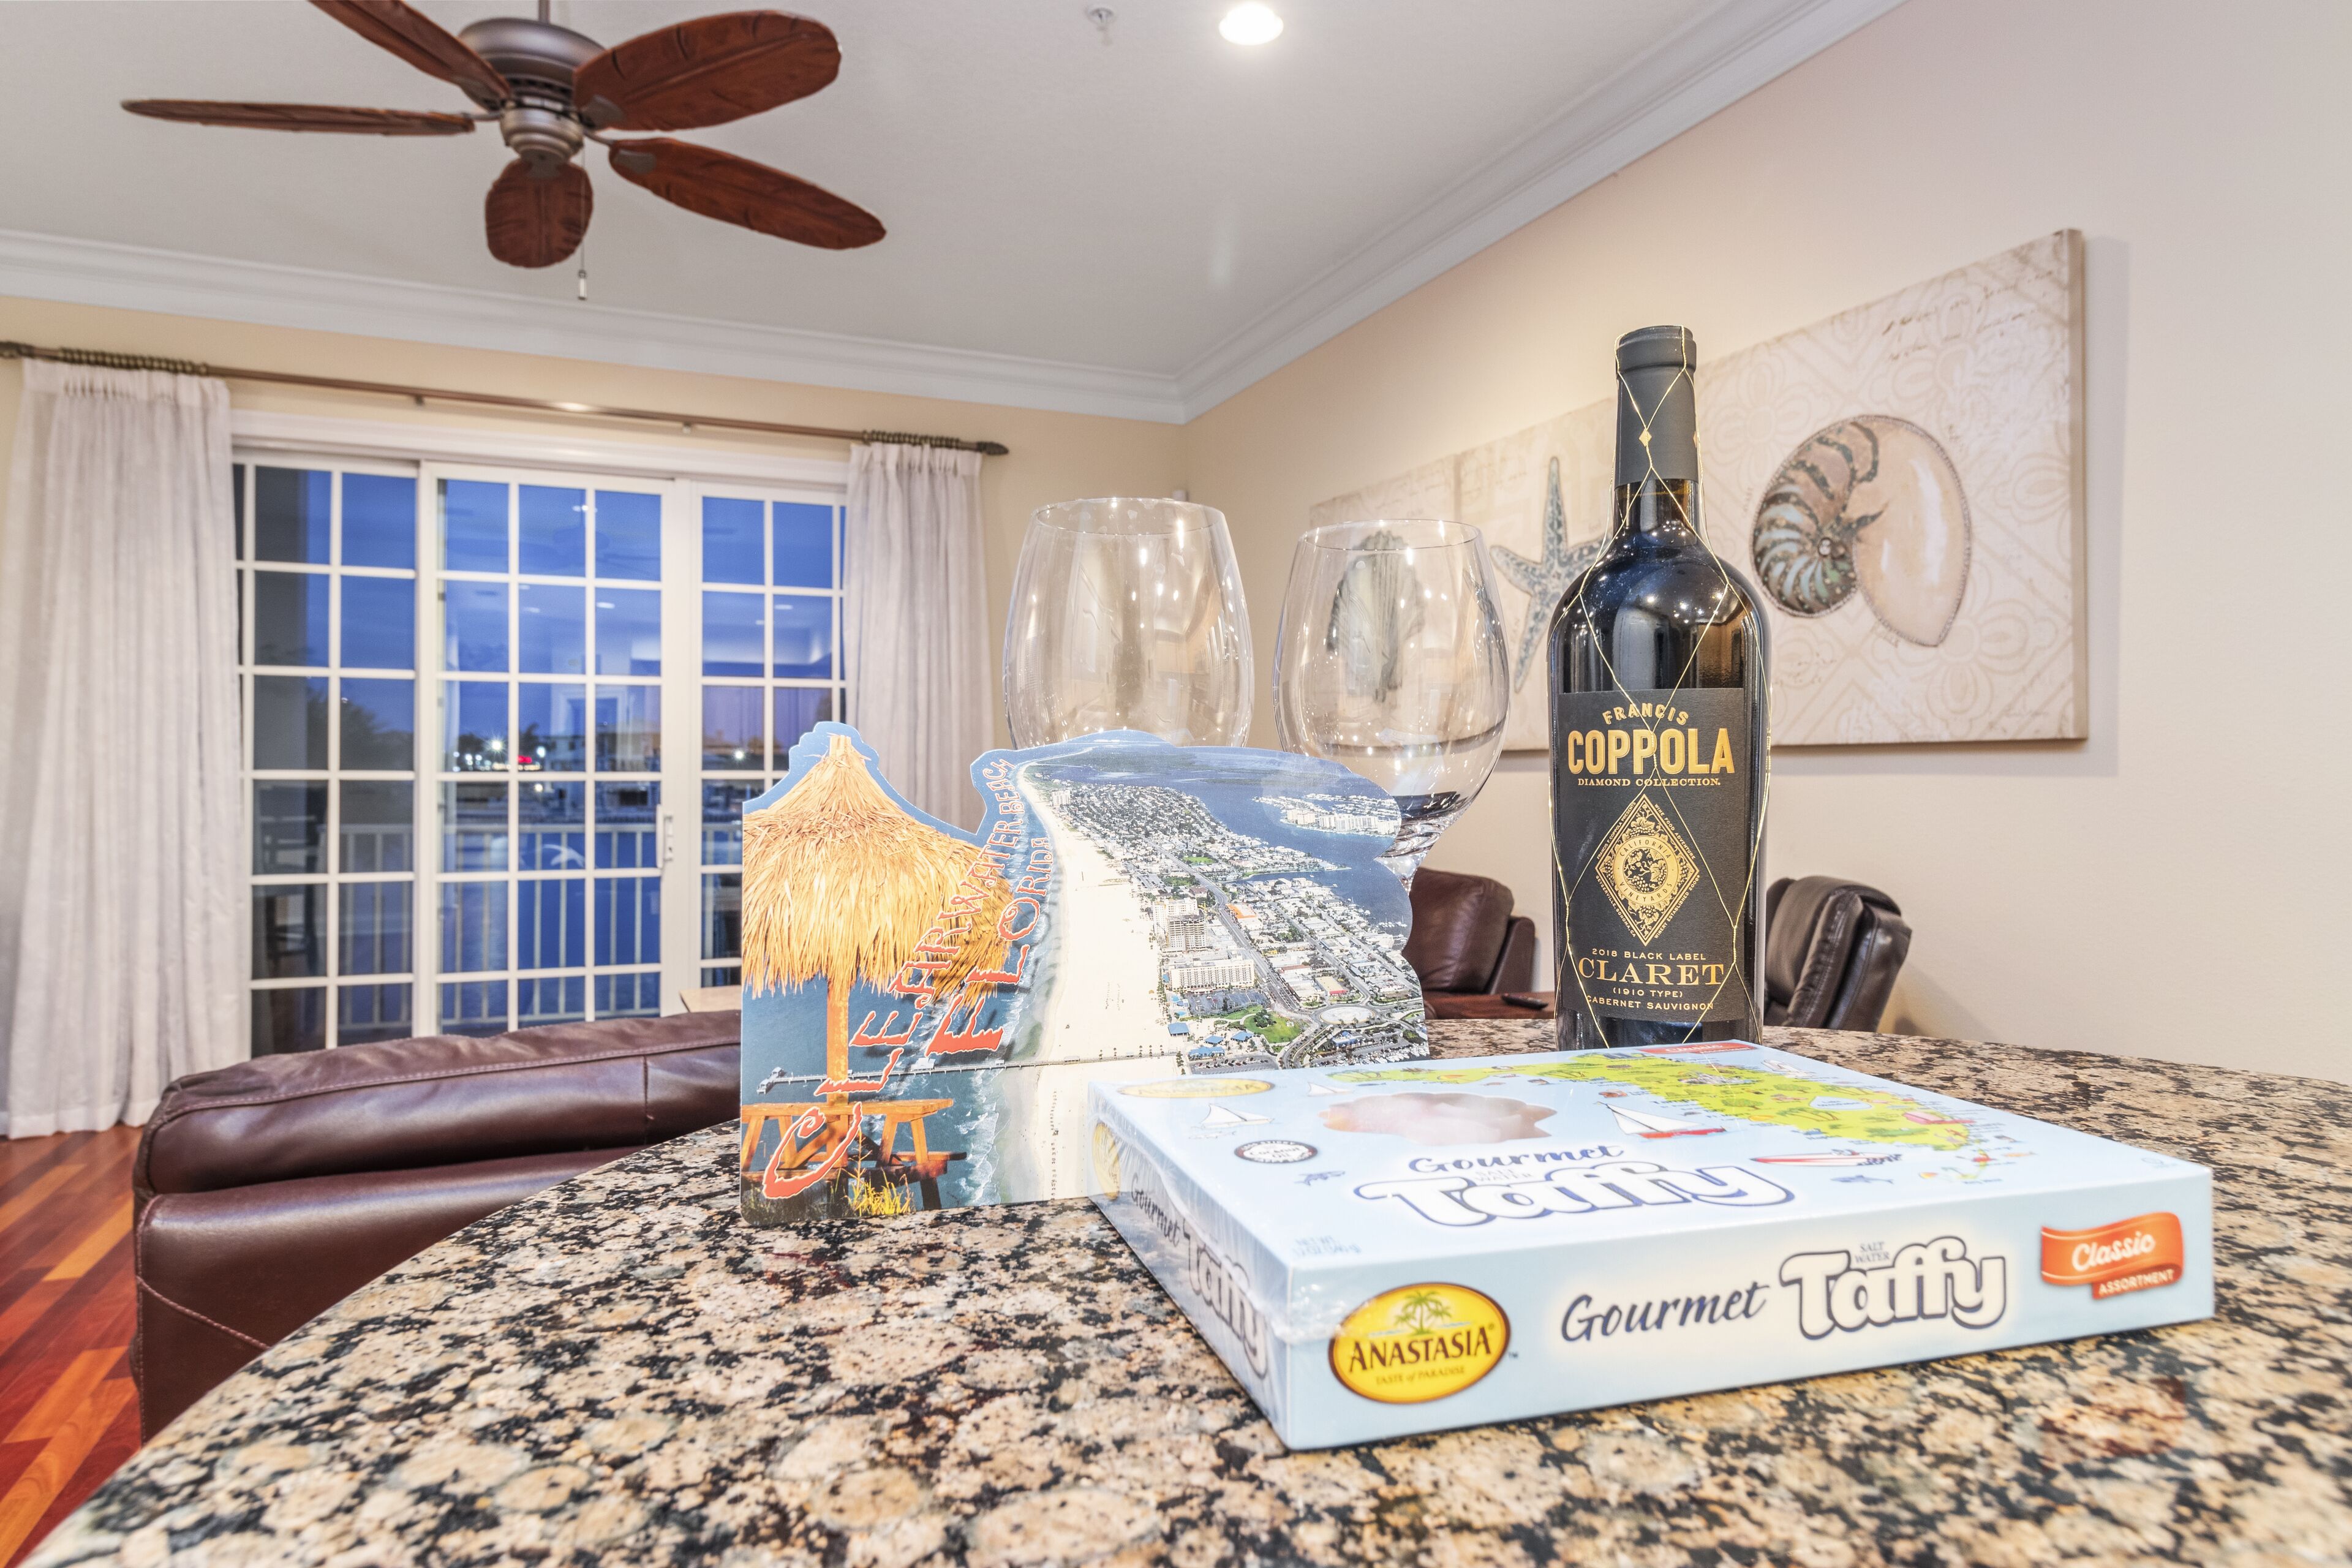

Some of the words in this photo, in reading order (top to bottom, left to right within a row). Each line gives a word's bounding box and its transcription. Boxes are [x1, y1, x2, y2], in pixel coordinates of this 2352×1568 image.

[1602, 703, 1689, 725] FRANCIS
[1567, 728, 1735, 774] COPPOLA
[1597, 843, 1608, 859] FRANCIS
[1609, 821, 1623, 840] COPPOLA
[1621, 802, 1636, 822] PRESENTS
[1620, 839, 1672, 858] CALIFORNIA
[1654, 804, 1665, 816] WINE
[1664, 817, 1675, 831] FOOD
[1674, 832, 1696, 860] ADVENTURE
[1619, 882, 1673, 902] VINEYARDS
[1654, 922, 1668, 939] WINERY
[1667, 892, 1689, 922] ESTABLISHED
[925, 837, 1054, 1057] FLORIDA
[1592, 948, 1618, 957] 2018
[1624, 951, 1663, 960] BLACK
[762, 820, 1023, 1199] CLEARWATER
[982, 758, 1025, 815] BEACH
[1578, 957, 1724, 986] CLARET
[1586, 995, 1642, 1009] CABERNET
[1646, 1002, 1714, 1011] SAUVIGNON
[1613, 987, 1645, 997] (1910
[1649, 990, 1683, 998] TYPE)
[1408, 1145, 1624, 1173] Gourmet
[1131, 1172, 1181, 1248] Gourmet
[1354, 1161, 1796, 1227] Taffy
[1855, 1251, 1890, 1263] WATER
[1860, 1241, 1885, 1252] SALT
[2071, 1231, 2156, 1272] Classic
[1778, 1235, 2007, 1341] Taffy
[2098, 1268, 2174, 1295] ASSORTMENT
[1561, 1281, 1771, 1342] Gourmet
[1349, 1325, 1492, 1373] ANASTASIA
